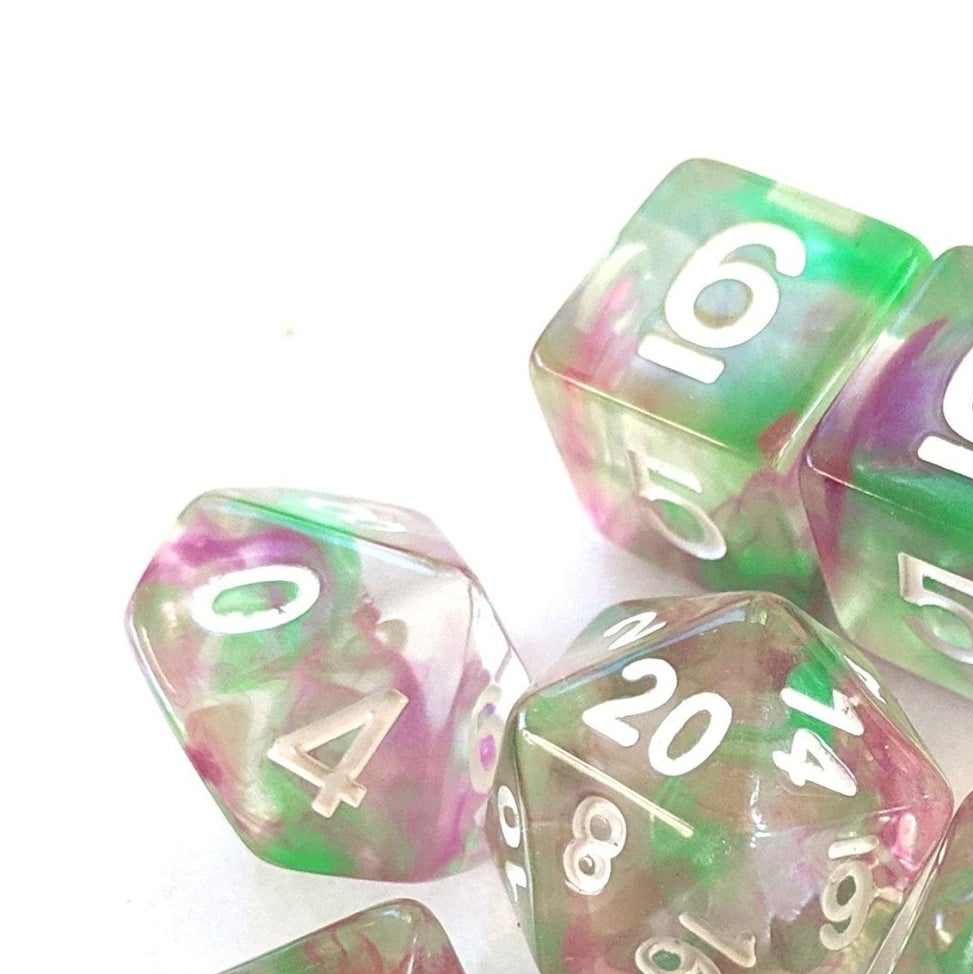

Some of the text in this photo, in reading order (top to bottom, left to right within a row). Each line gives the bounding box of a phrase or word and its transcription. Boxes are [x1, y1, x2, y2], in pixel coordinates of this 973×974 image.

[638, 222, 806, 384] 6
[628, 452, 727, 561] 5
[190, 563, 321, 635] 0
[603, 610, 668, 651] 2
[267, 688, 409, 818] 4
[582, 657, 733, 776] 20
[772, 686, 865, 796] 14
[563, 795, 627, 895] 8
